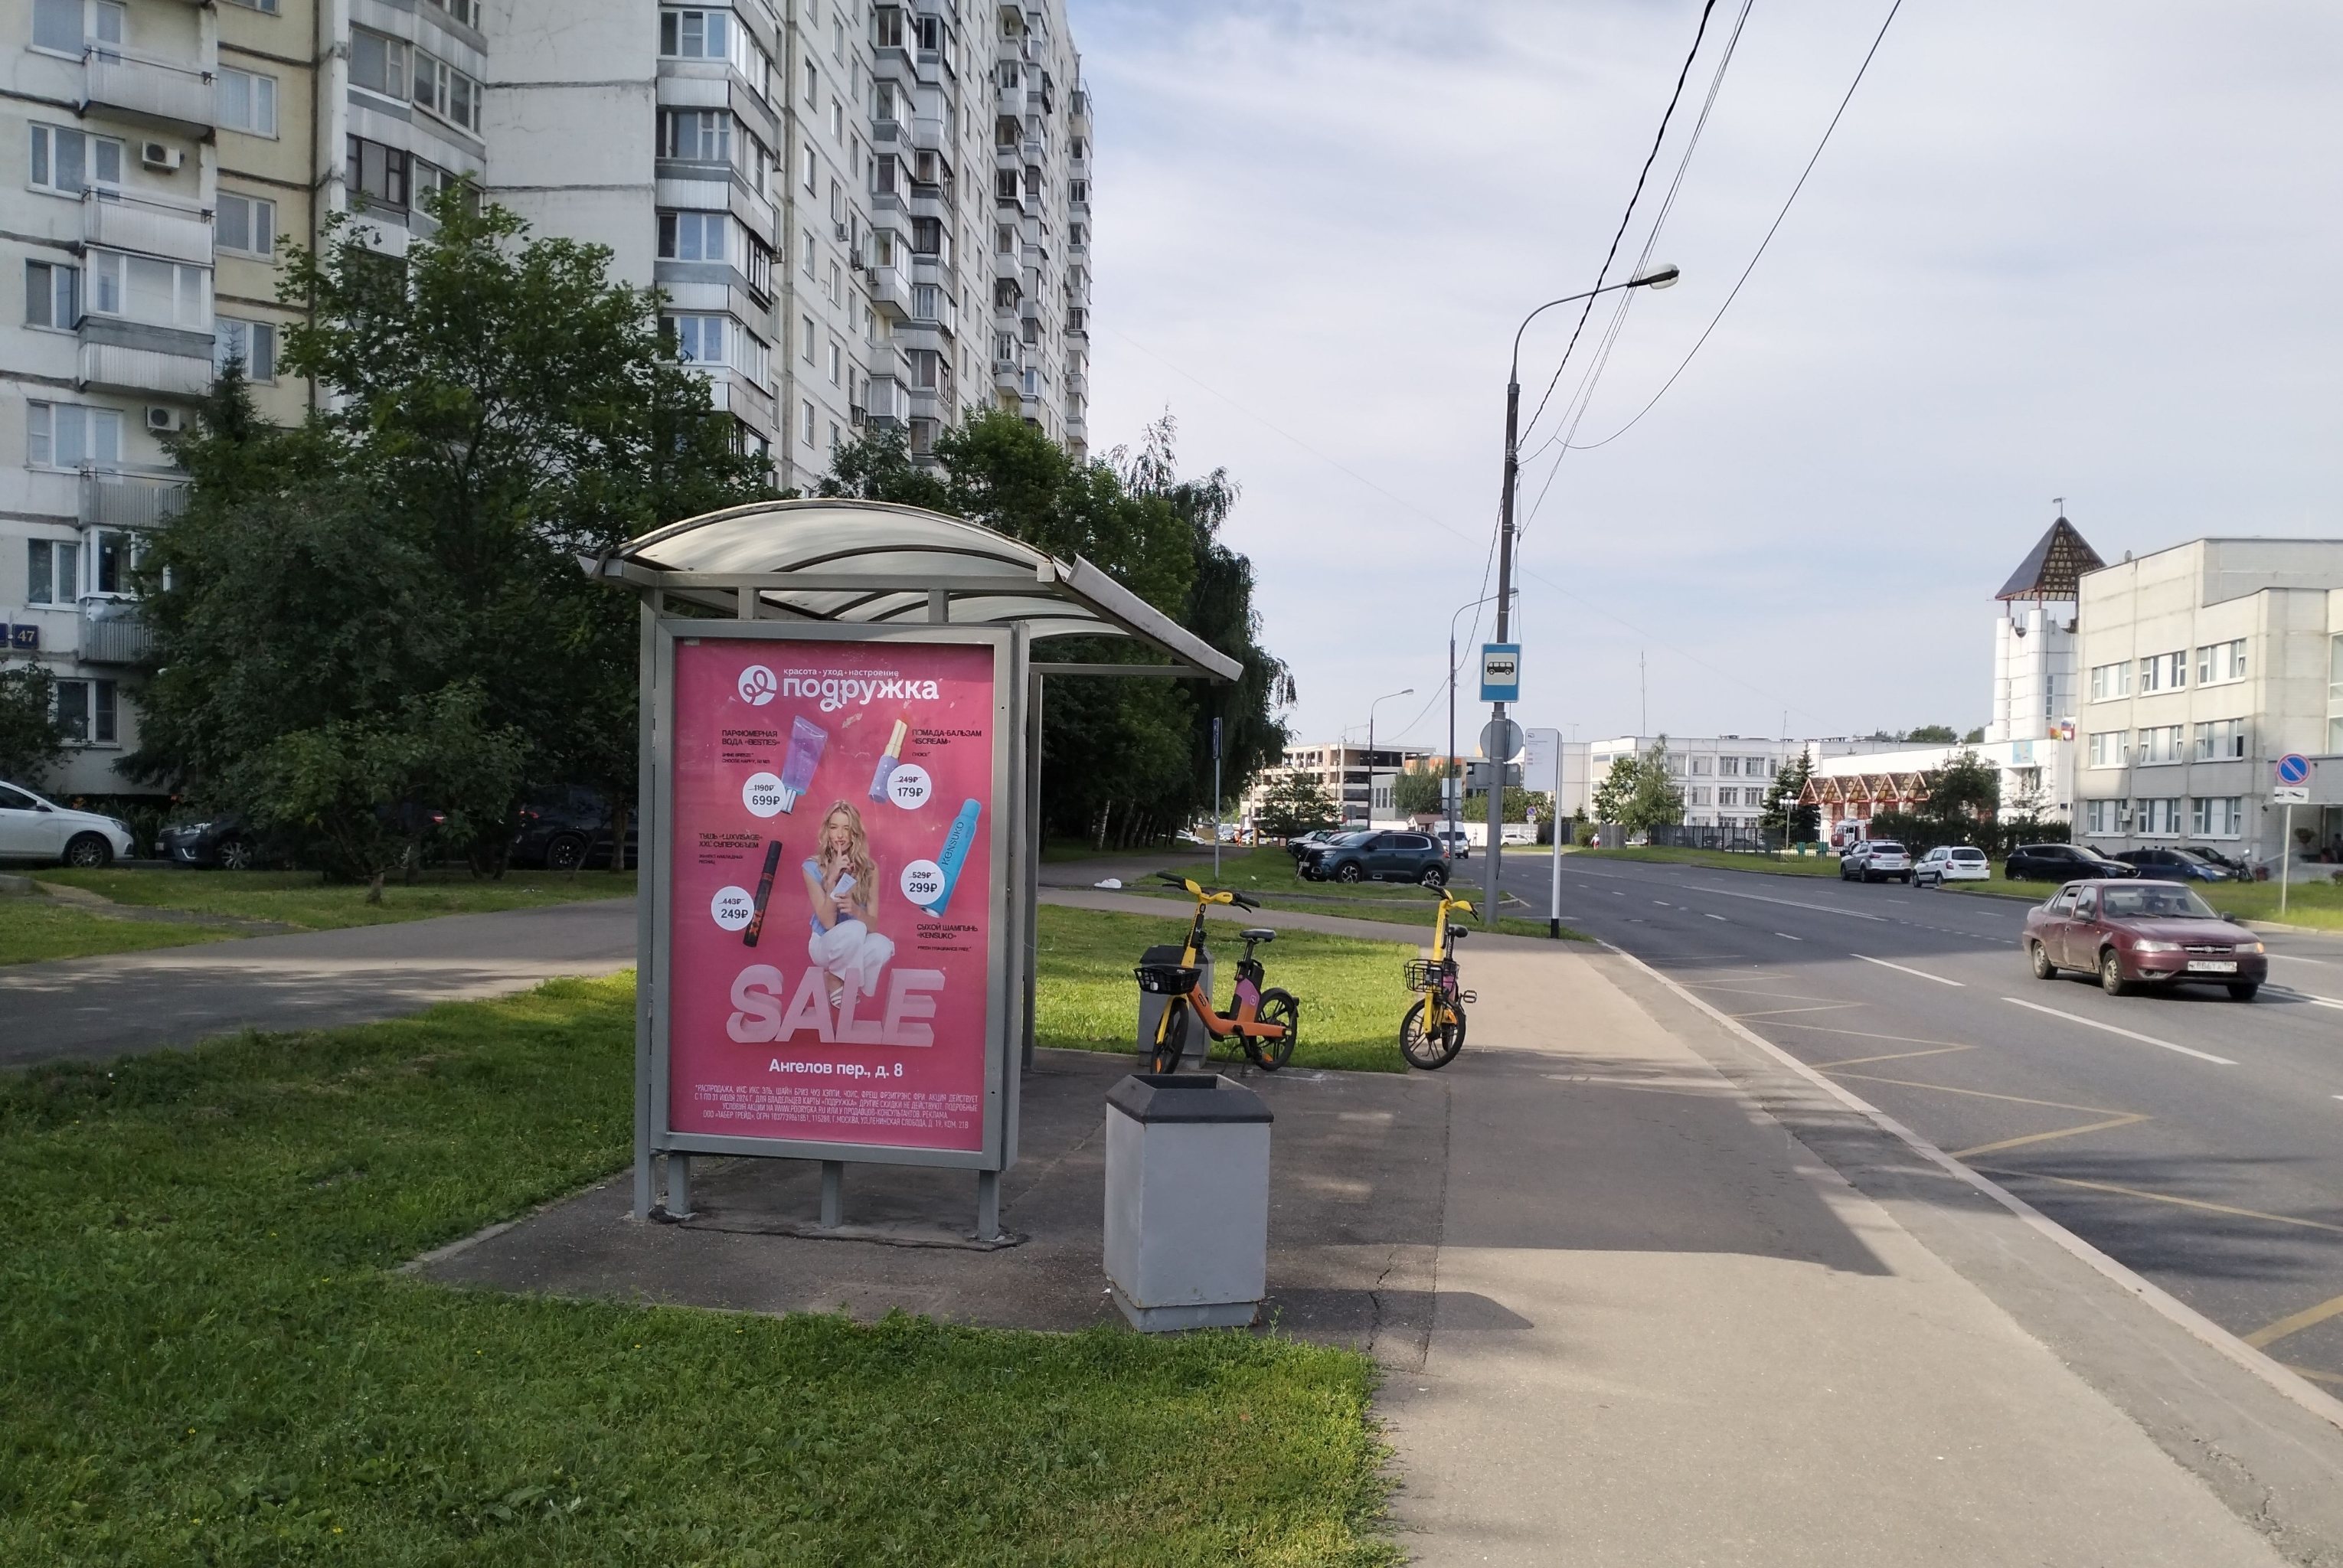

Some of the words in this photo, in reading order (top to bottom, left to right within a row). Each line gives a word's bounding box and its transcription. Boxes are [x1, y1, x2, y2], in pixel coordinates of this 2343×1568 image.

[18, 630, 35, 642] 47
[783, 678, 939, 712] подружка
[897, 787, 923, 797] 179₽
[752, 795, 780, 805] 699₽
[909, 883, 937, 893] 299₽
[721, 909, 748, 919] 249₽
[726, 964, 946, 1047] SALE
[769, 1058, 832, 1074] Ангелов
[836, 1063, 871, 1079] пер.,
[875, 1064, 890, 1078] д.
[893, 1063, 903, 1077] 8
[736, 1094, 748, 1102] 2024
[802, 1096, 820, 1105] КАРТЫ
